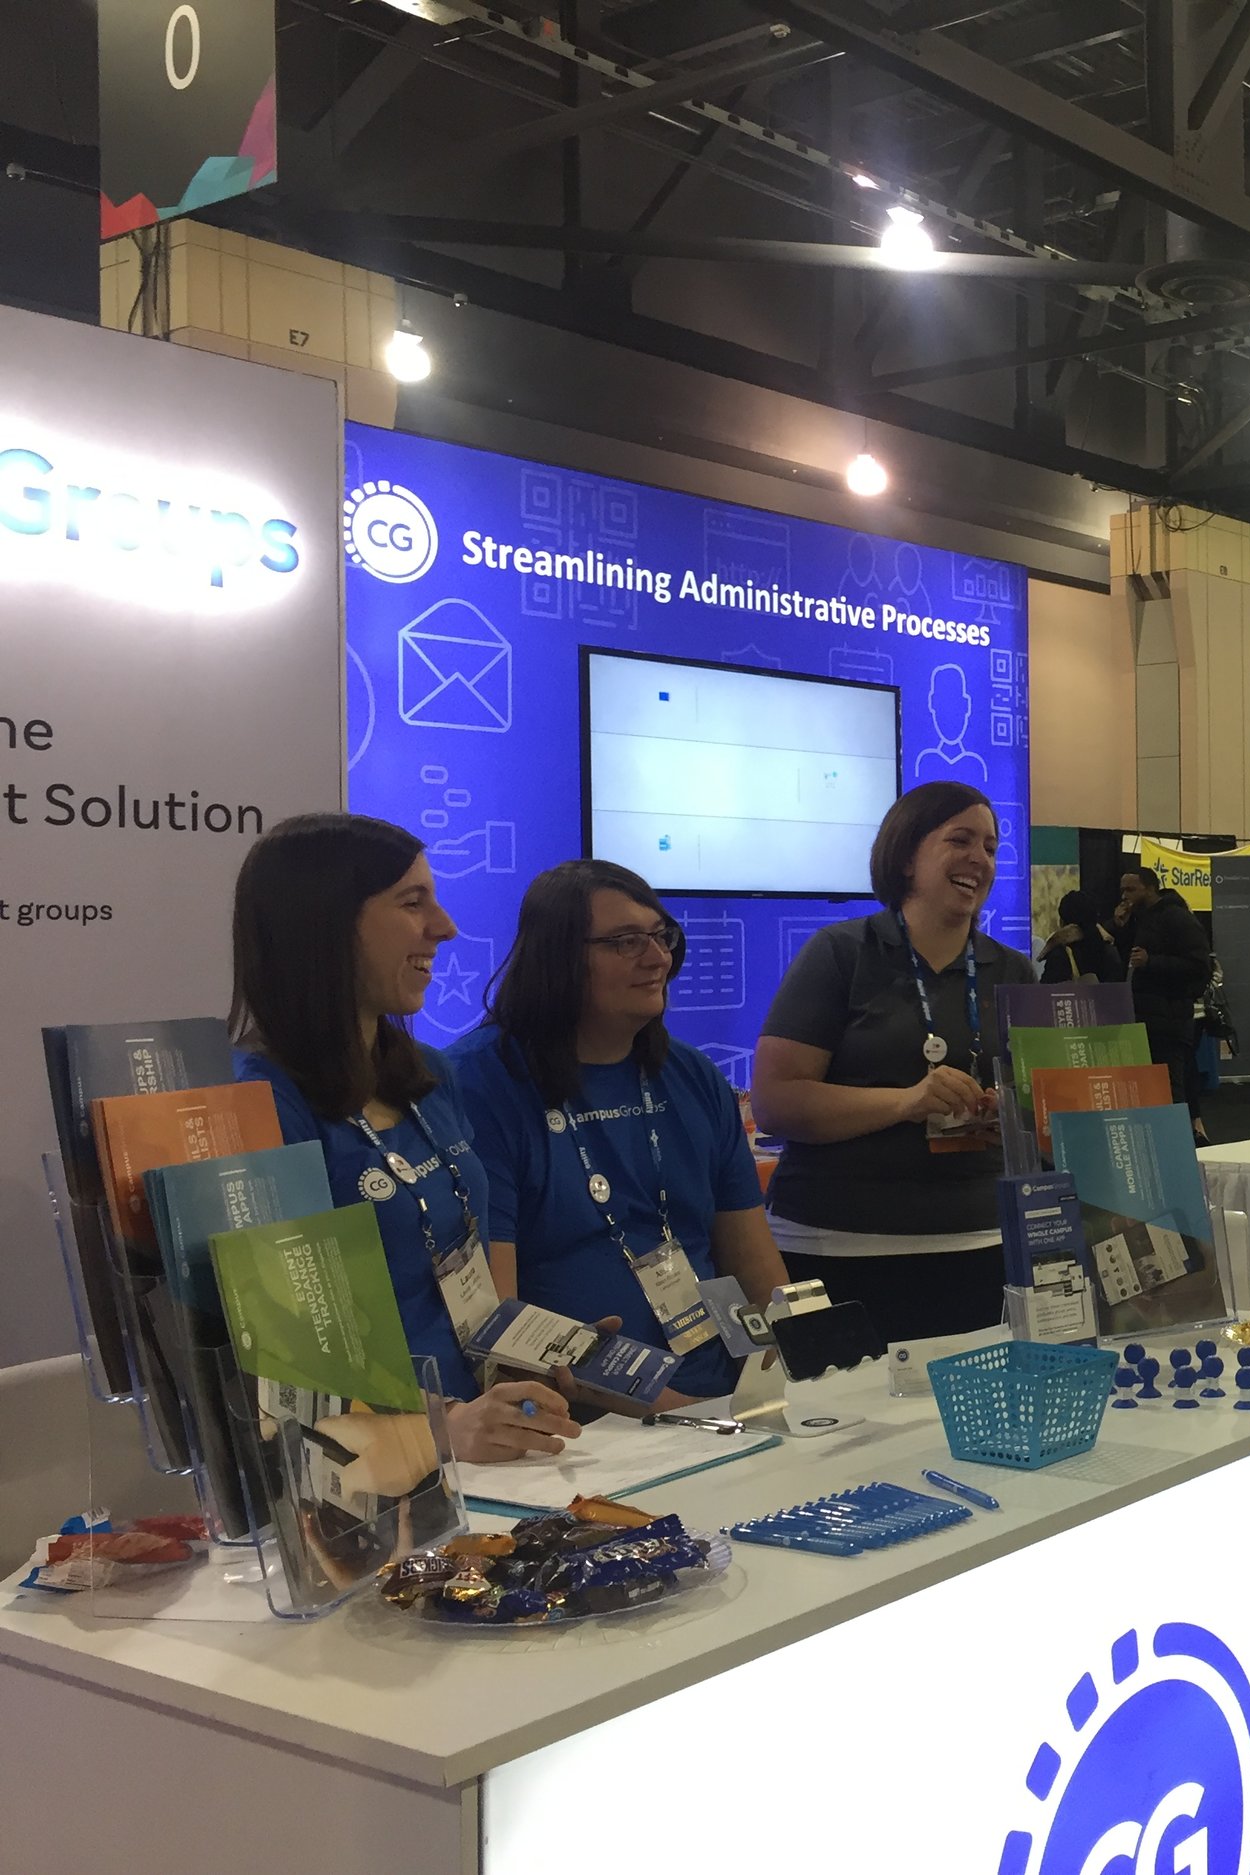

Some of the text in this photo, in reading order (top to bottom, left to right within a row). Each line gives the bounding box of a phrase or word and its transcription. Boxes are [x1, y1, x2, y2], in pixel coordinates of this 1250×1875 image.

[165, 4, 200, 90] 0
[289, 329, 309, 346] E7
[367, 519, 413, 552] CG
[462, 530, 990, 647] Streamlining Administrative Processes
[44, 783, 263, 834] Solution
[1171, 867, 1212, 887] StarRe
[17, 902, 113, 926] groups
[1109, 1124, 1124, 1169] CAMPUS
[1117, 1124, 1136, 1194] MOBILE APPS
[235, 1180, 253, 1223] APPS
[369, 1178, 389, 1191] CG
[284, 1249, 306, 1302] EVENT
[293, 1245, 331, 1354] ATTENDANCE
[302, 1244, 333, 1328] TRACKING
